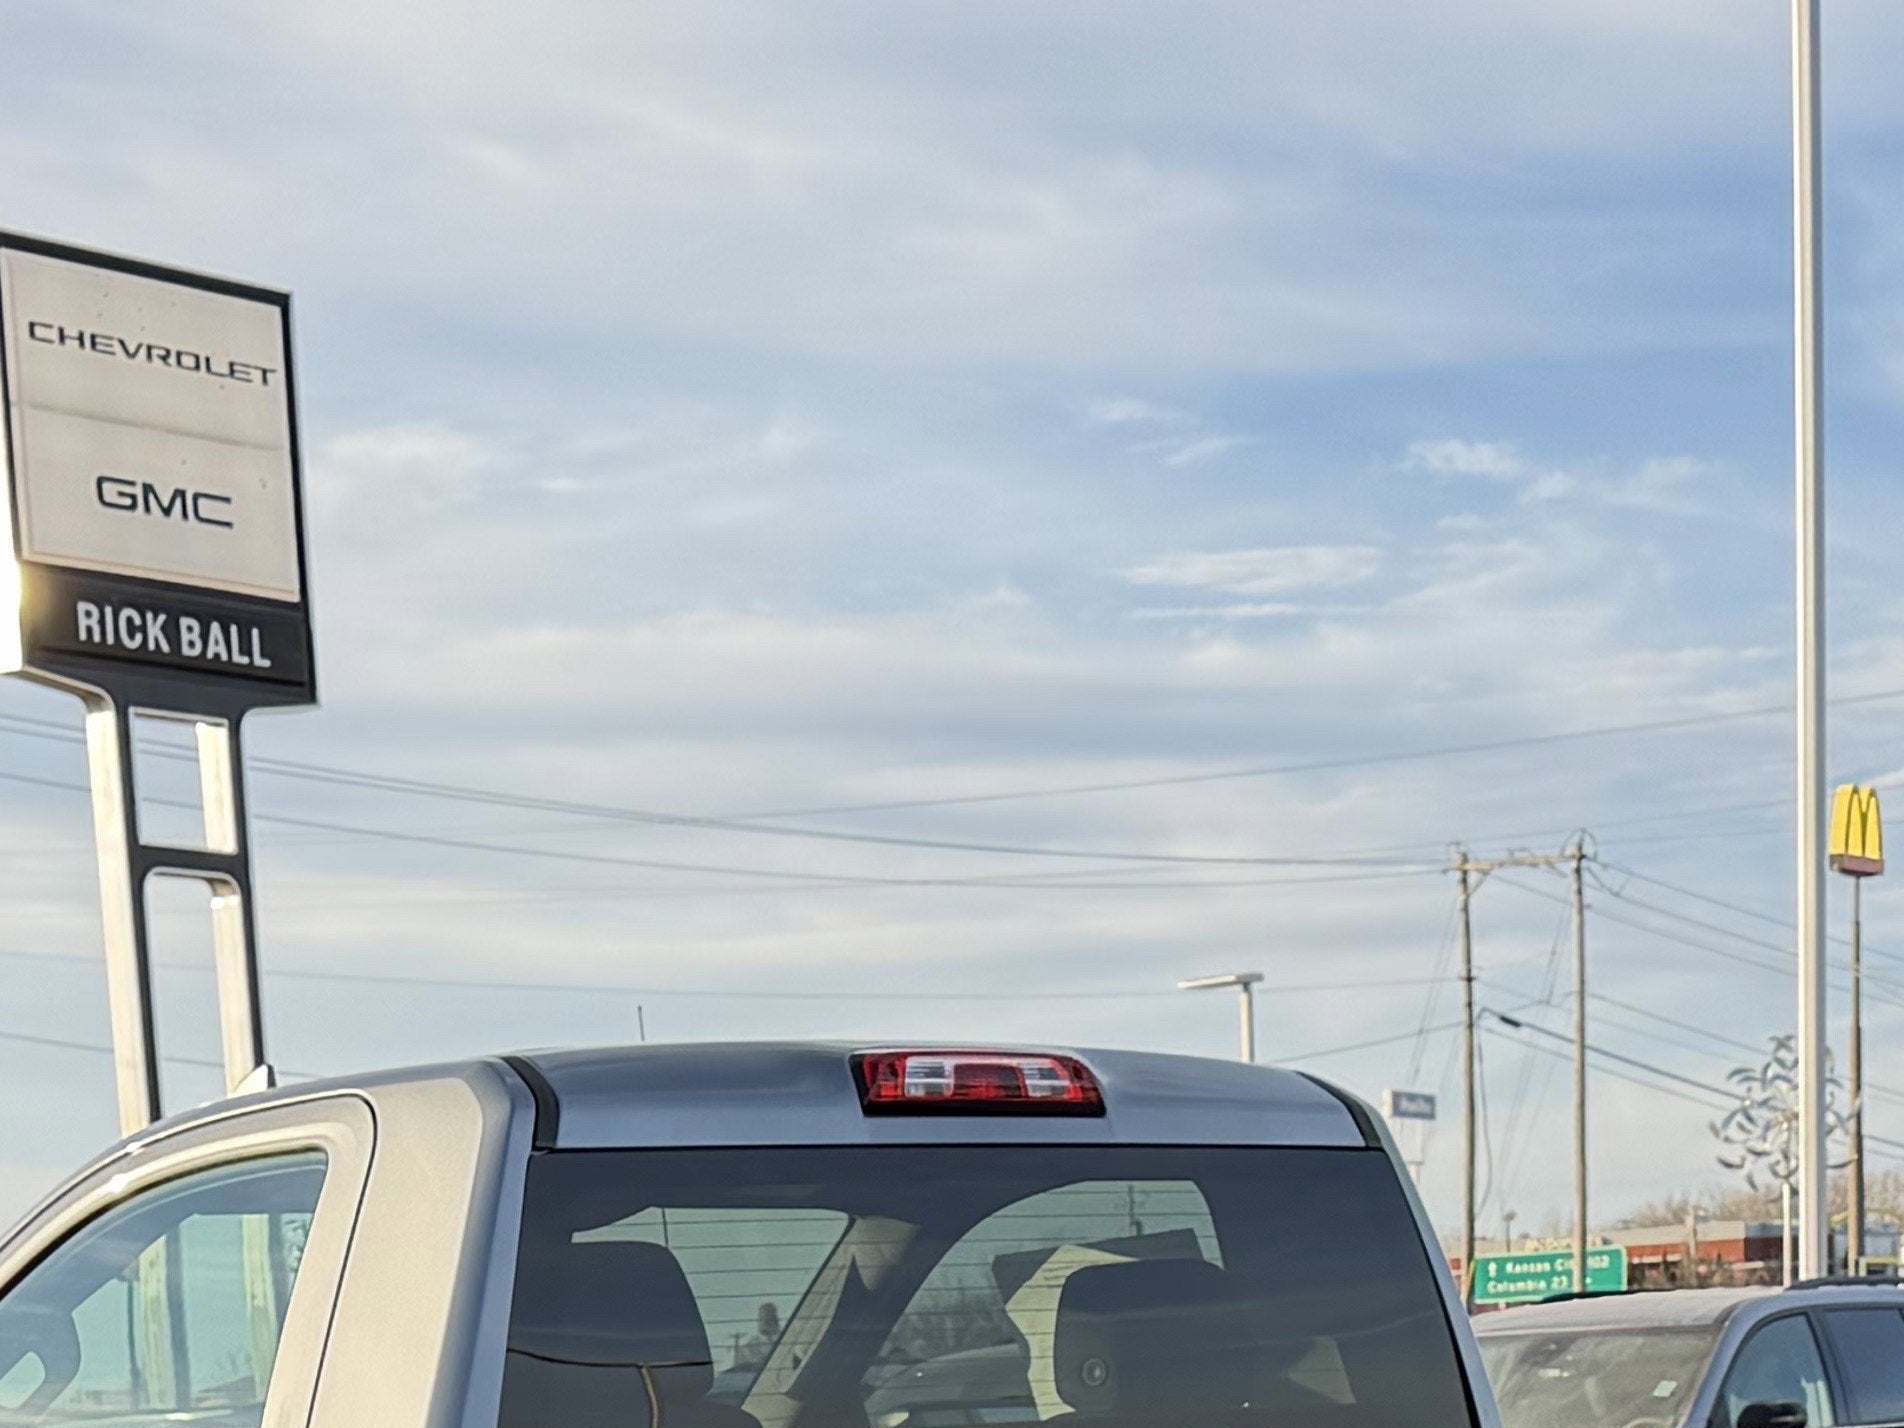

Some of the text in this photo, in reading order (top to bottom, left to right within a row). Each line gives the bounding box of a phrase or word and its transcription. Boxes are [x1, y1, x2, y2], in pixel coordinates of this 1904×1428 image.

[28, 321, 278, 388] CHEVROLET
[96, 475, 234, 529] GMC
[76, 601, 272, 669] RICK BALL
